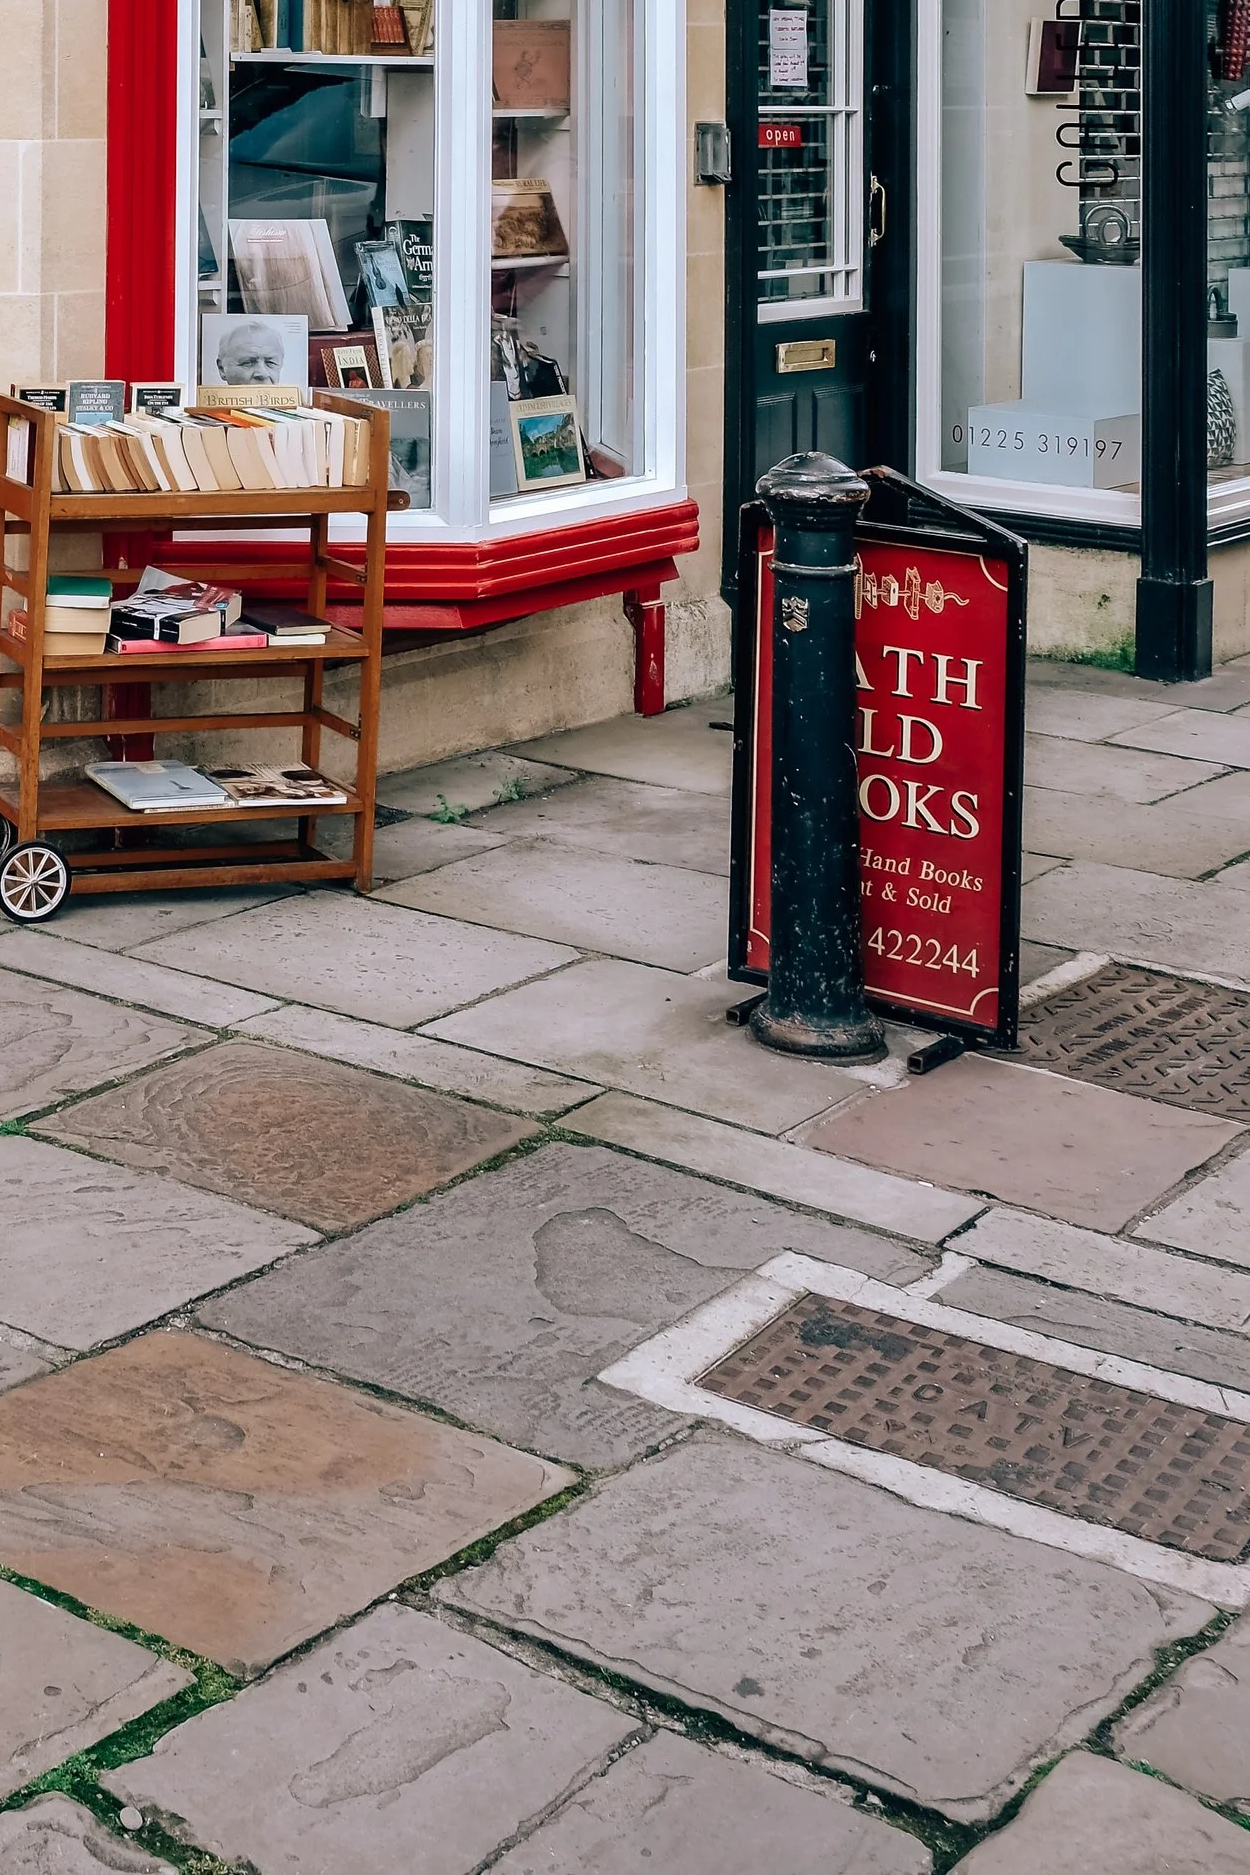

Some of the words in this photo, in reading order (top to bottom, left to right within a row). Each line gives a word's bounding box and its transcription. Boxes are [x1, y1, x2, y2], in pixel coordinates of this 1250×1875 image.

[766, 128, 796, 146] open
[336, 355, 365, 366] INDIA
[206, 391, 253, 406] BRITISH
[258, 391, 296, 406] BIRDS
[952, 424, 1025, 451] 01225
[1037, 433, 1123, 461] 319197
[858, 706, 943, 764] LD
[859, 774, 980, 839] OKS
[918, 860, 983, 892] Books
[881, 882, 897, 902] &
[906, 887, 952, 914] Sold
[867, 926, 980, 979] 422244
[911, 1382, 1095, 1450] CATV
